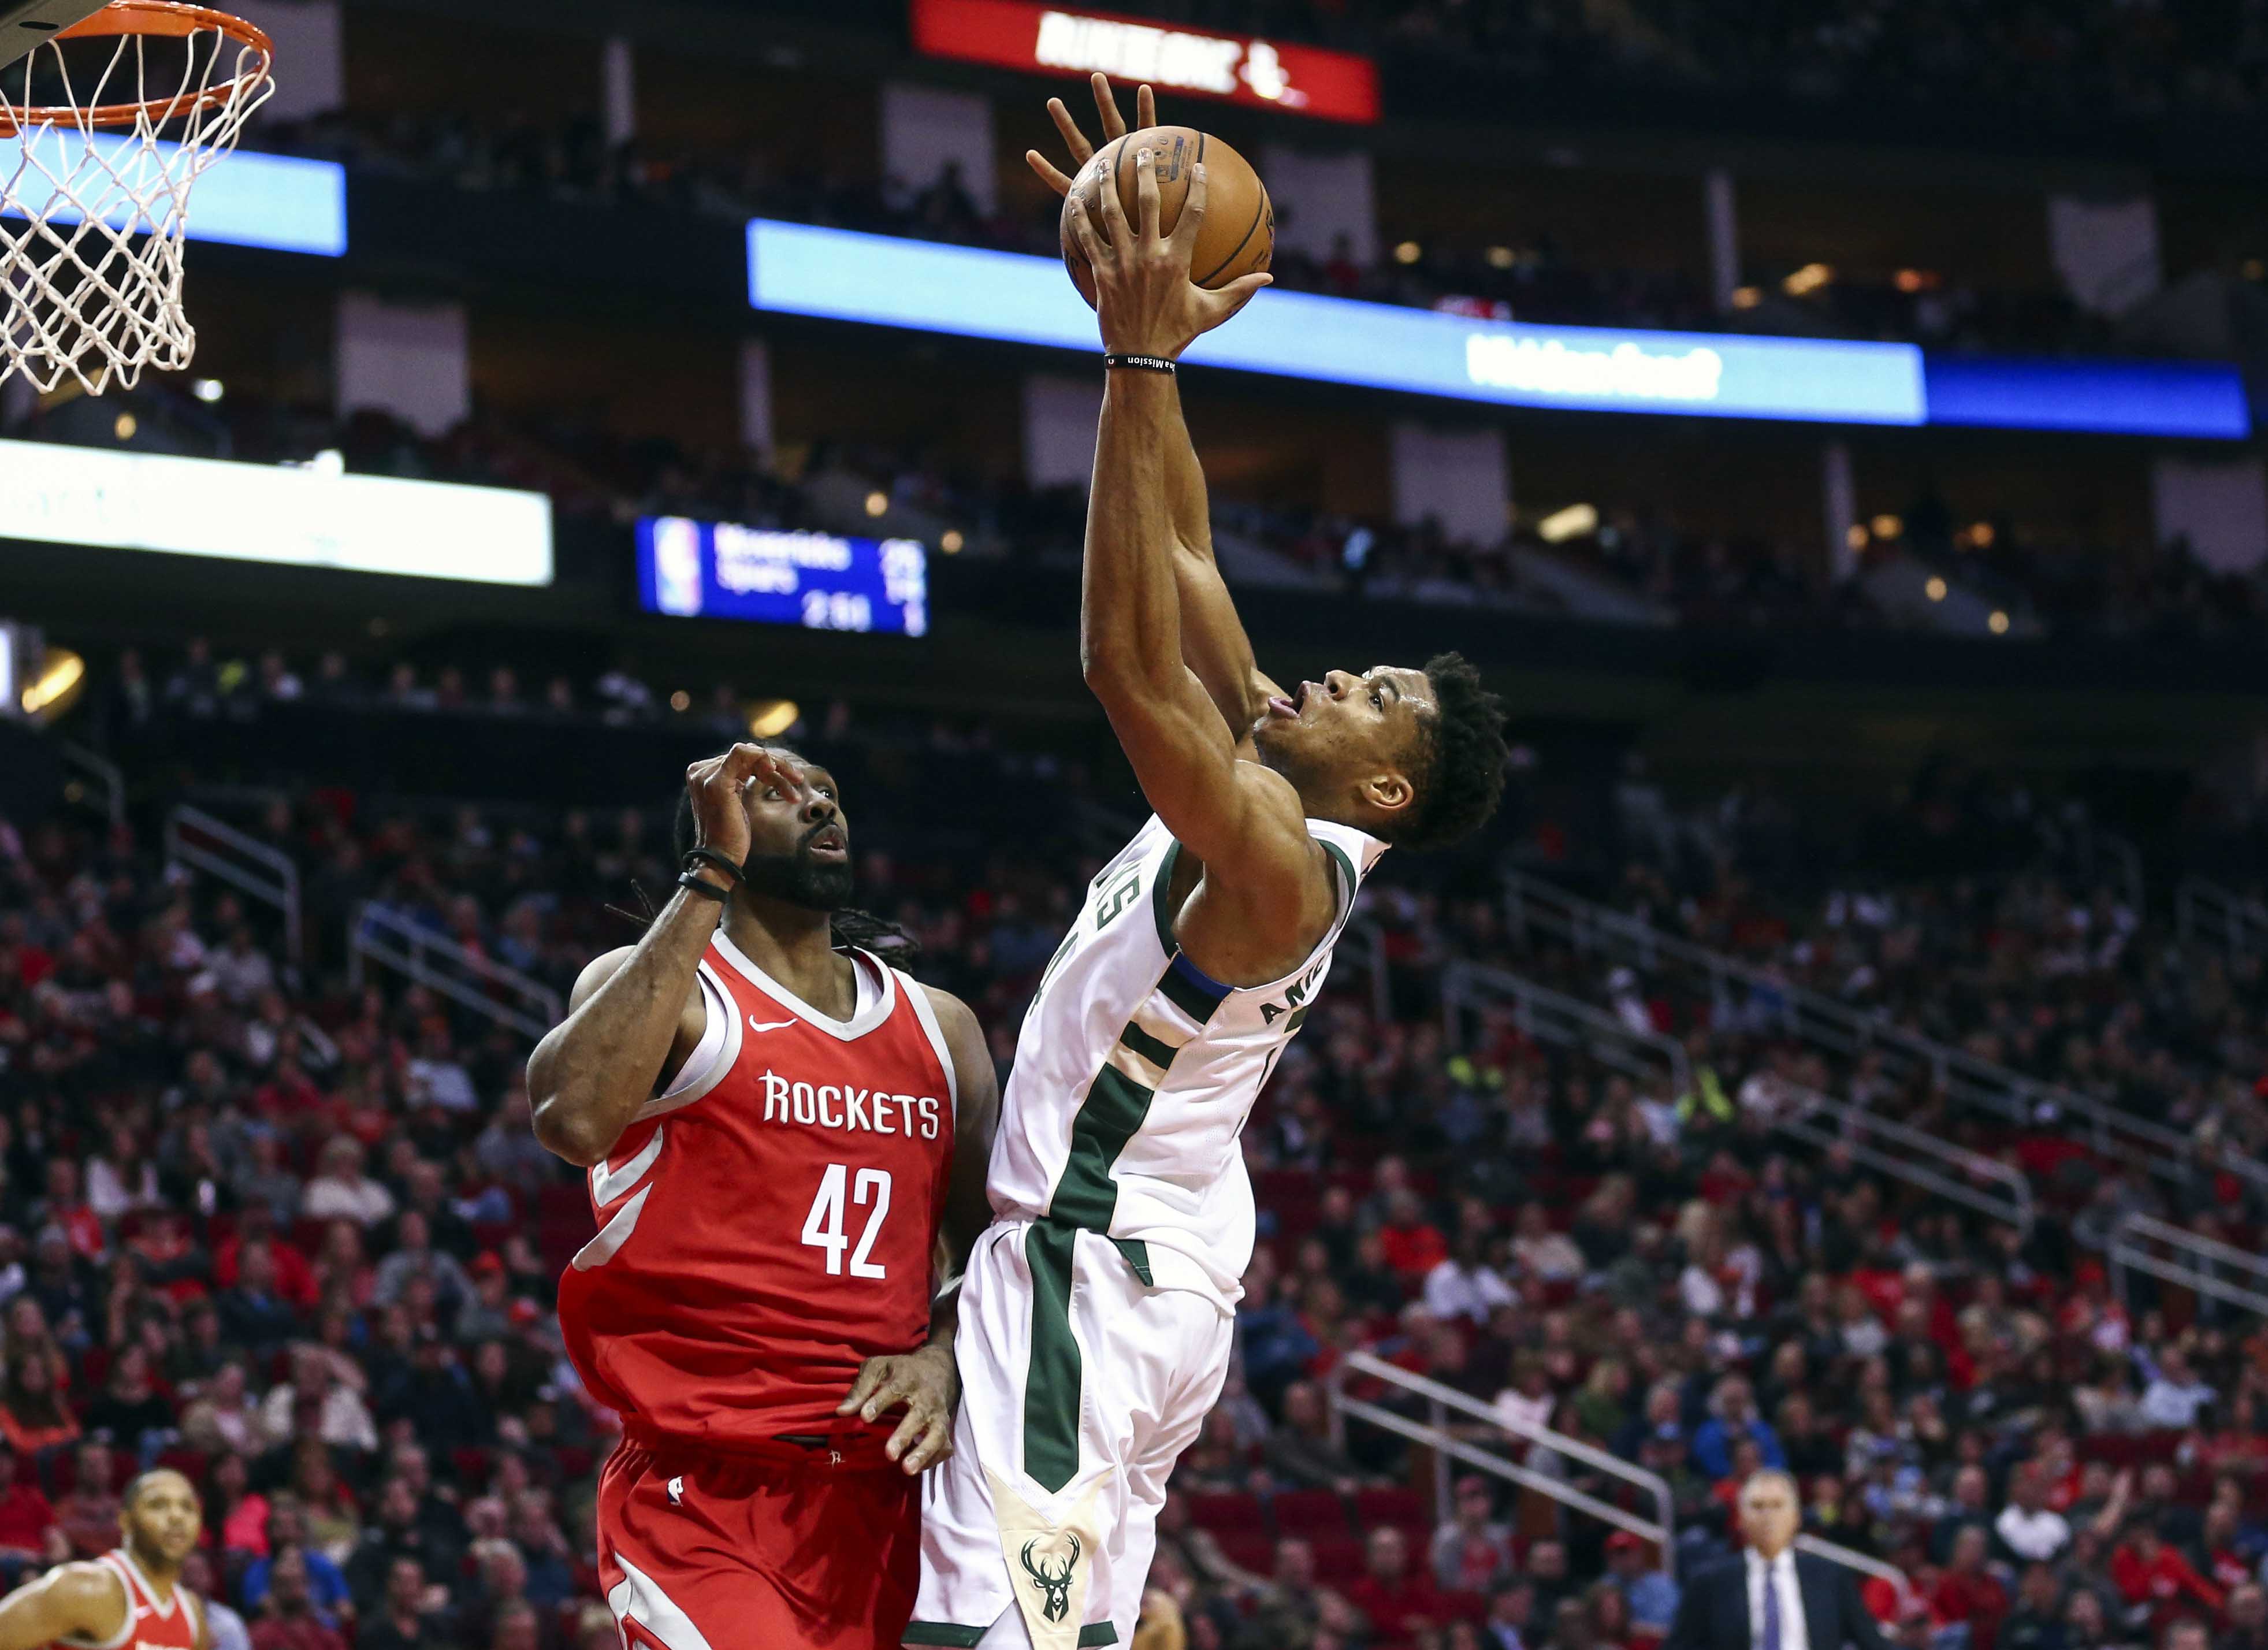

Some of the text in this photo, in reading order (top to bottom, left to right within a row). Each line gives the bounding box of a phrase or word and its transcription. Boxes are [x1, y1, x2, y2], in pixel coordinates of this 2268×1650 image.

[1128, 356, 1164, 368] Mission
[758, 1069, 939, 1140] ROCKETS
[801, 1163, 892, 1280] 42
